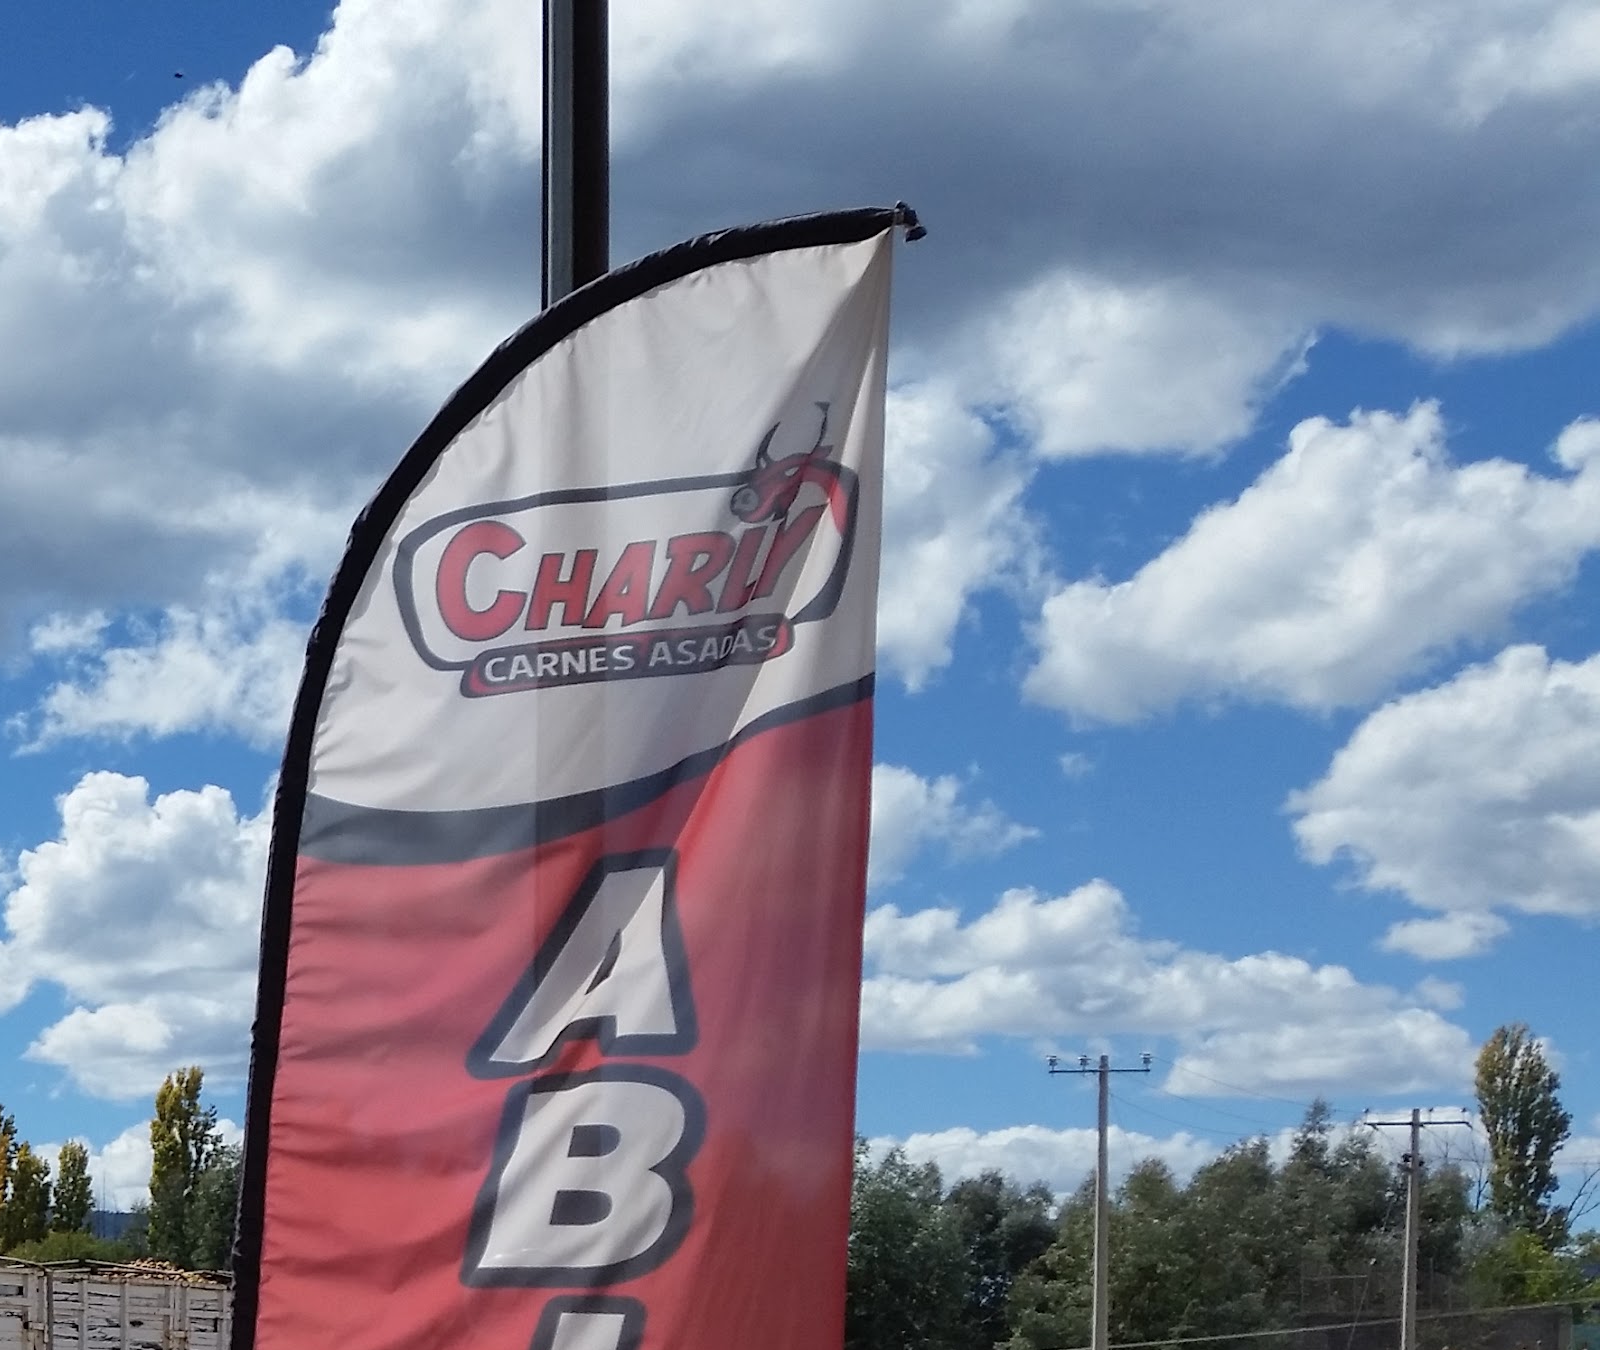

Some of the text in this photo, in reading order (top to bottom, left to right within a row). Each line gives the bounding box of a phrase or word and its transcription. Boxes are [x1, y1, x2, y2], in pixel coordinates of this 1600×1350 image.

[436, 504, 830, 642] CHARLY
[483, 624, 777, 683] CARNES ASADAS
